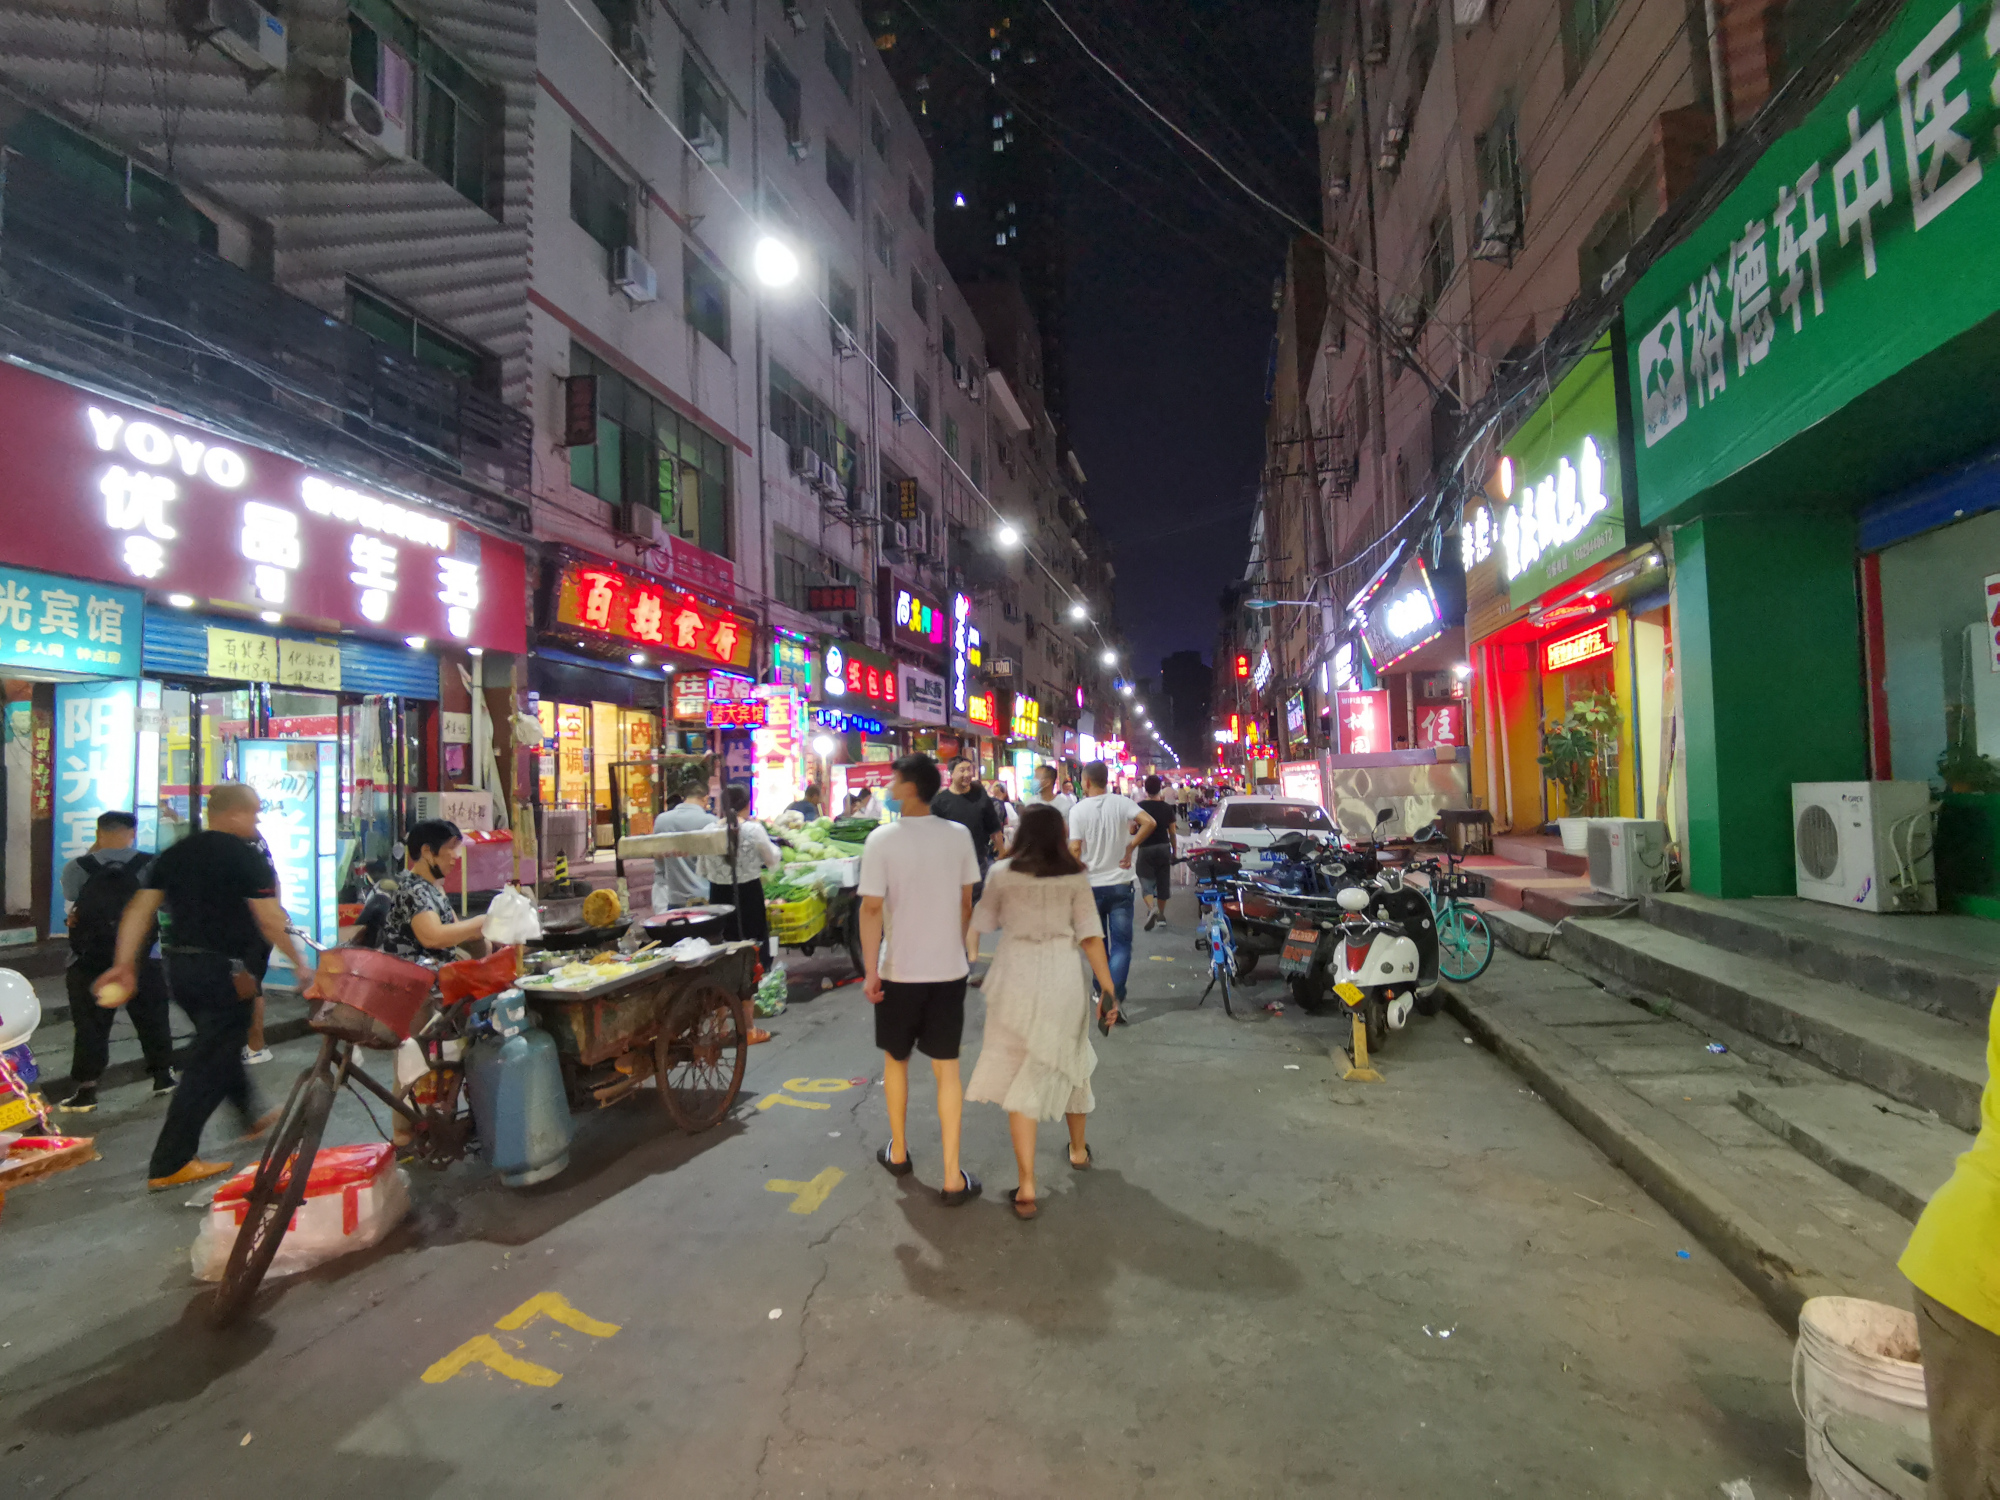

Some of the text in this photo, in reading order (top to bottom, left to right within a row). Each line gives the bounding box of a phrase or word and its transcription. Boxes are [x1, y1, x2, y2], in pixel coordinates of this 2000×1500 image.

[1687, 0, 2000, 410] 裕德轩中医
[88, 406, 247, 487] YOYO
[0, 580, 124, 645] 光宾馆
[675, 674, 707, 715] 住宿
[711, 704, 766, 724] 蓝天宾馆
[1421, 709, 1455, 748] 住
